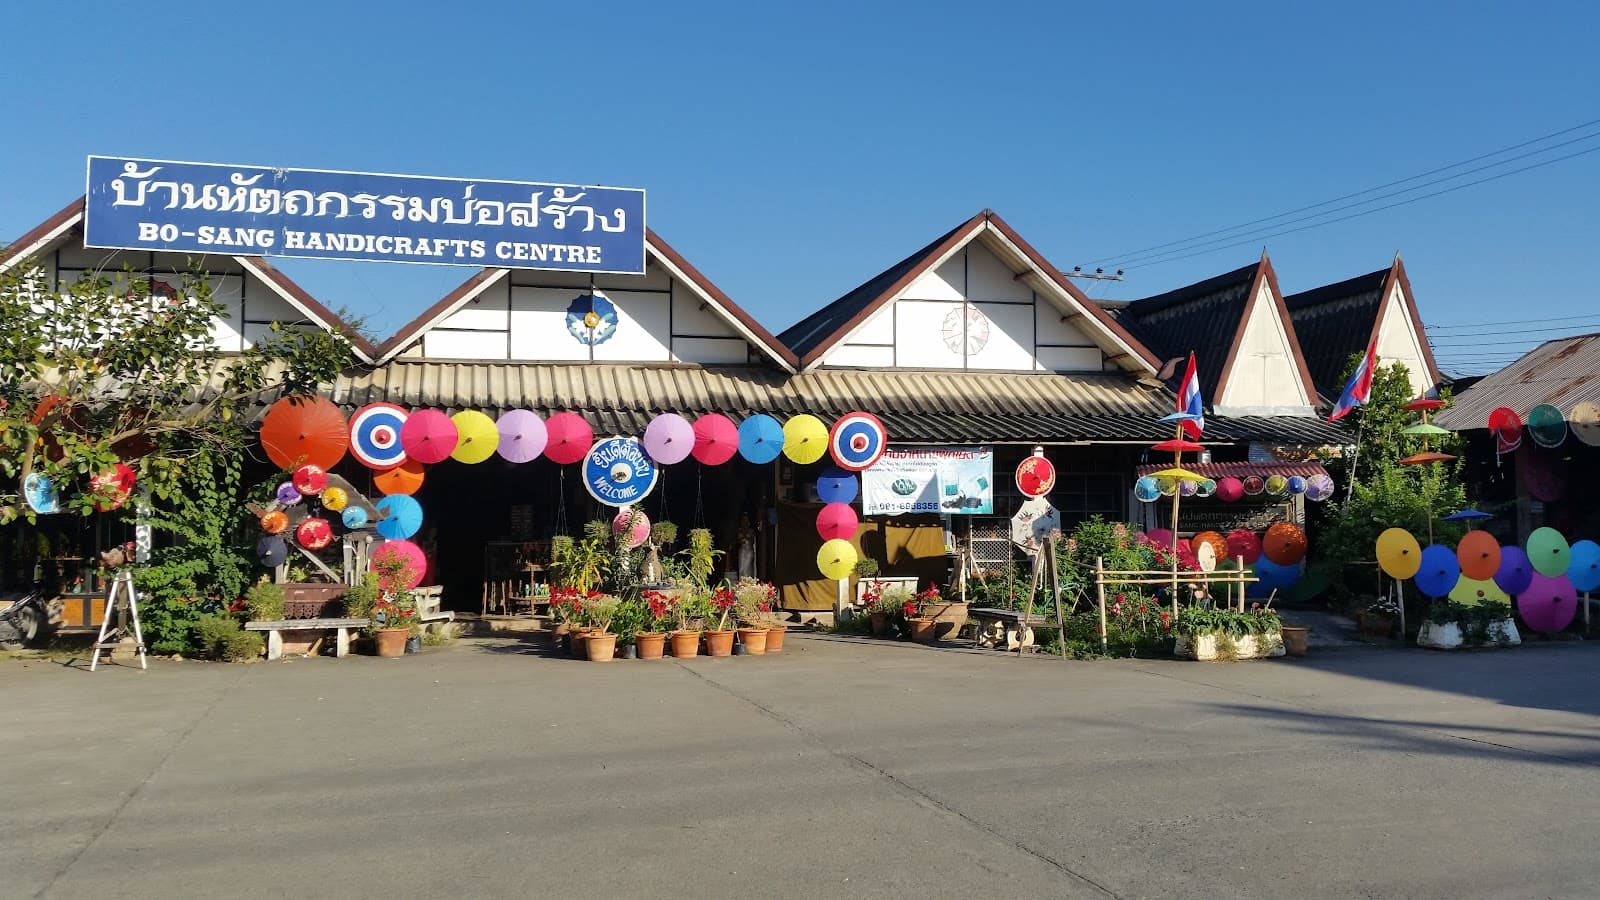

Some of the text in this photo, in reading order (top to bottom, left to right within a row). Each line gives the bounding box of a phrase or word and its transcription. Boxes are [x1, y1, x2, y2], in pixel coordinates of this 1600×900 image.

[111, 161, 626, 233] บ้านหัตถกรรมบ่อสร้าง
[138, 222, 602, 264] BO-SANG HANDICRAFTS CENTRE
[593, 476, 639, 499] WELCOME
